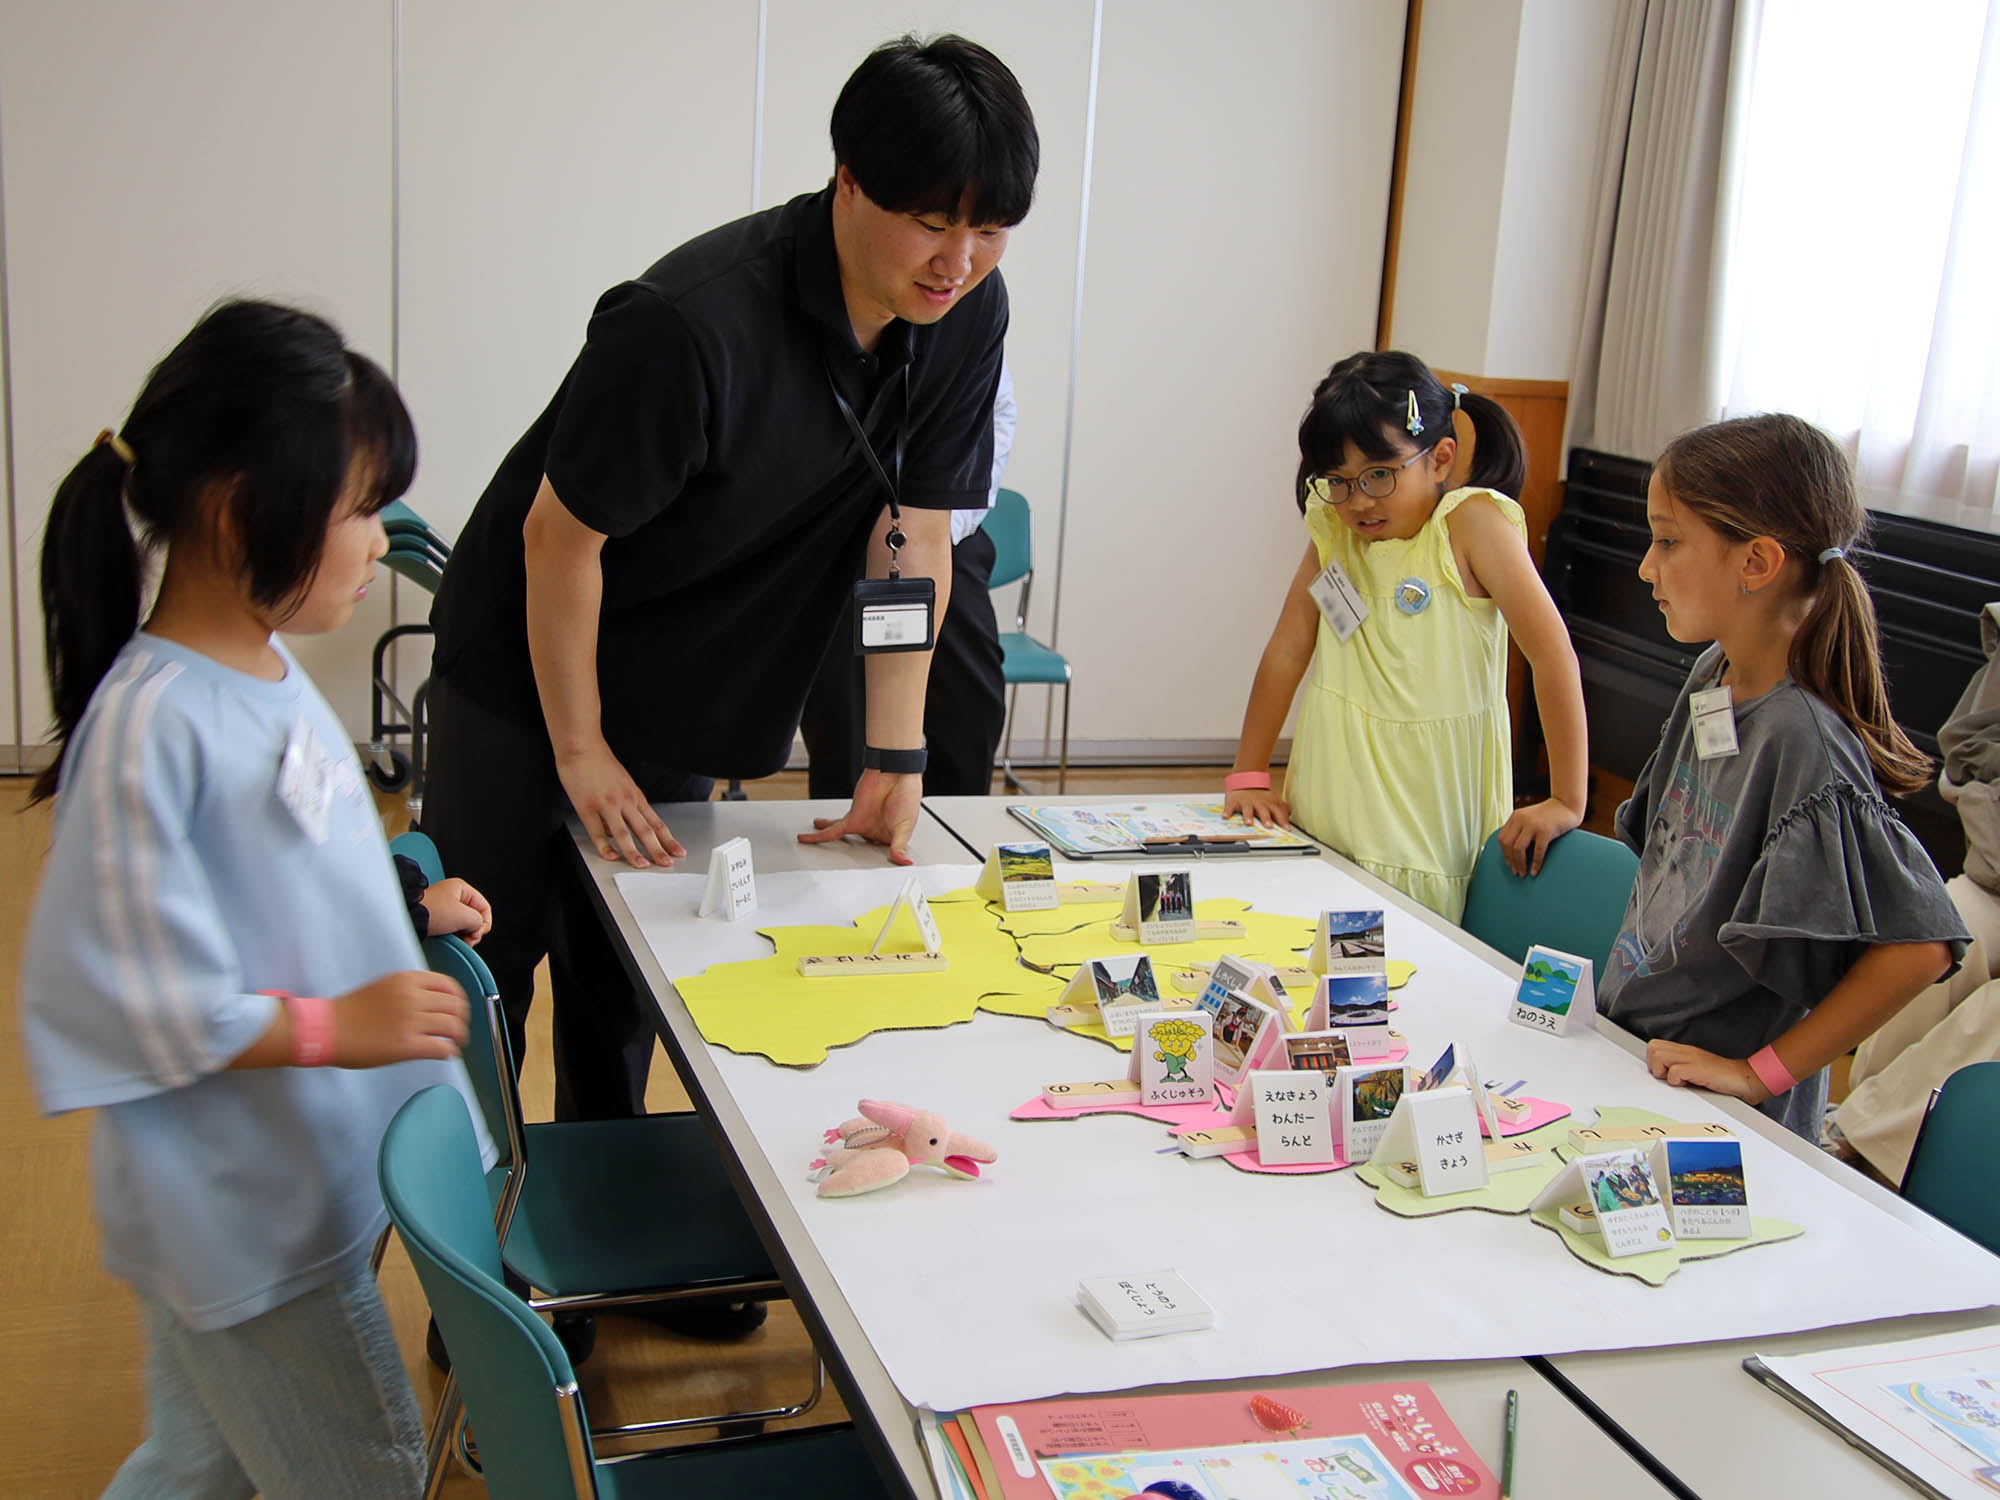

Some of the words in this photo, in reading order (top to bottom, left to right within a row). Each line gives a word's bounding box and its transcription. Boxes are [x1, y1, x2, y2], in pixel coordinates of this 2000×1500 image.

[1516, 1007, 1556, 1030] ねのうえ
[1150, 1087, 1206, 1100] ふくじゅそう
[1264, 1089, 1319, 1102] えなきょう
[1272, 1113, 1315, 1125] わんだー
[1280, 1135, 1313, 1147] らんど
[1435, 1131, 1464, 1147] かさぎ
[1439, 1155, 1468, 1170] きょう
